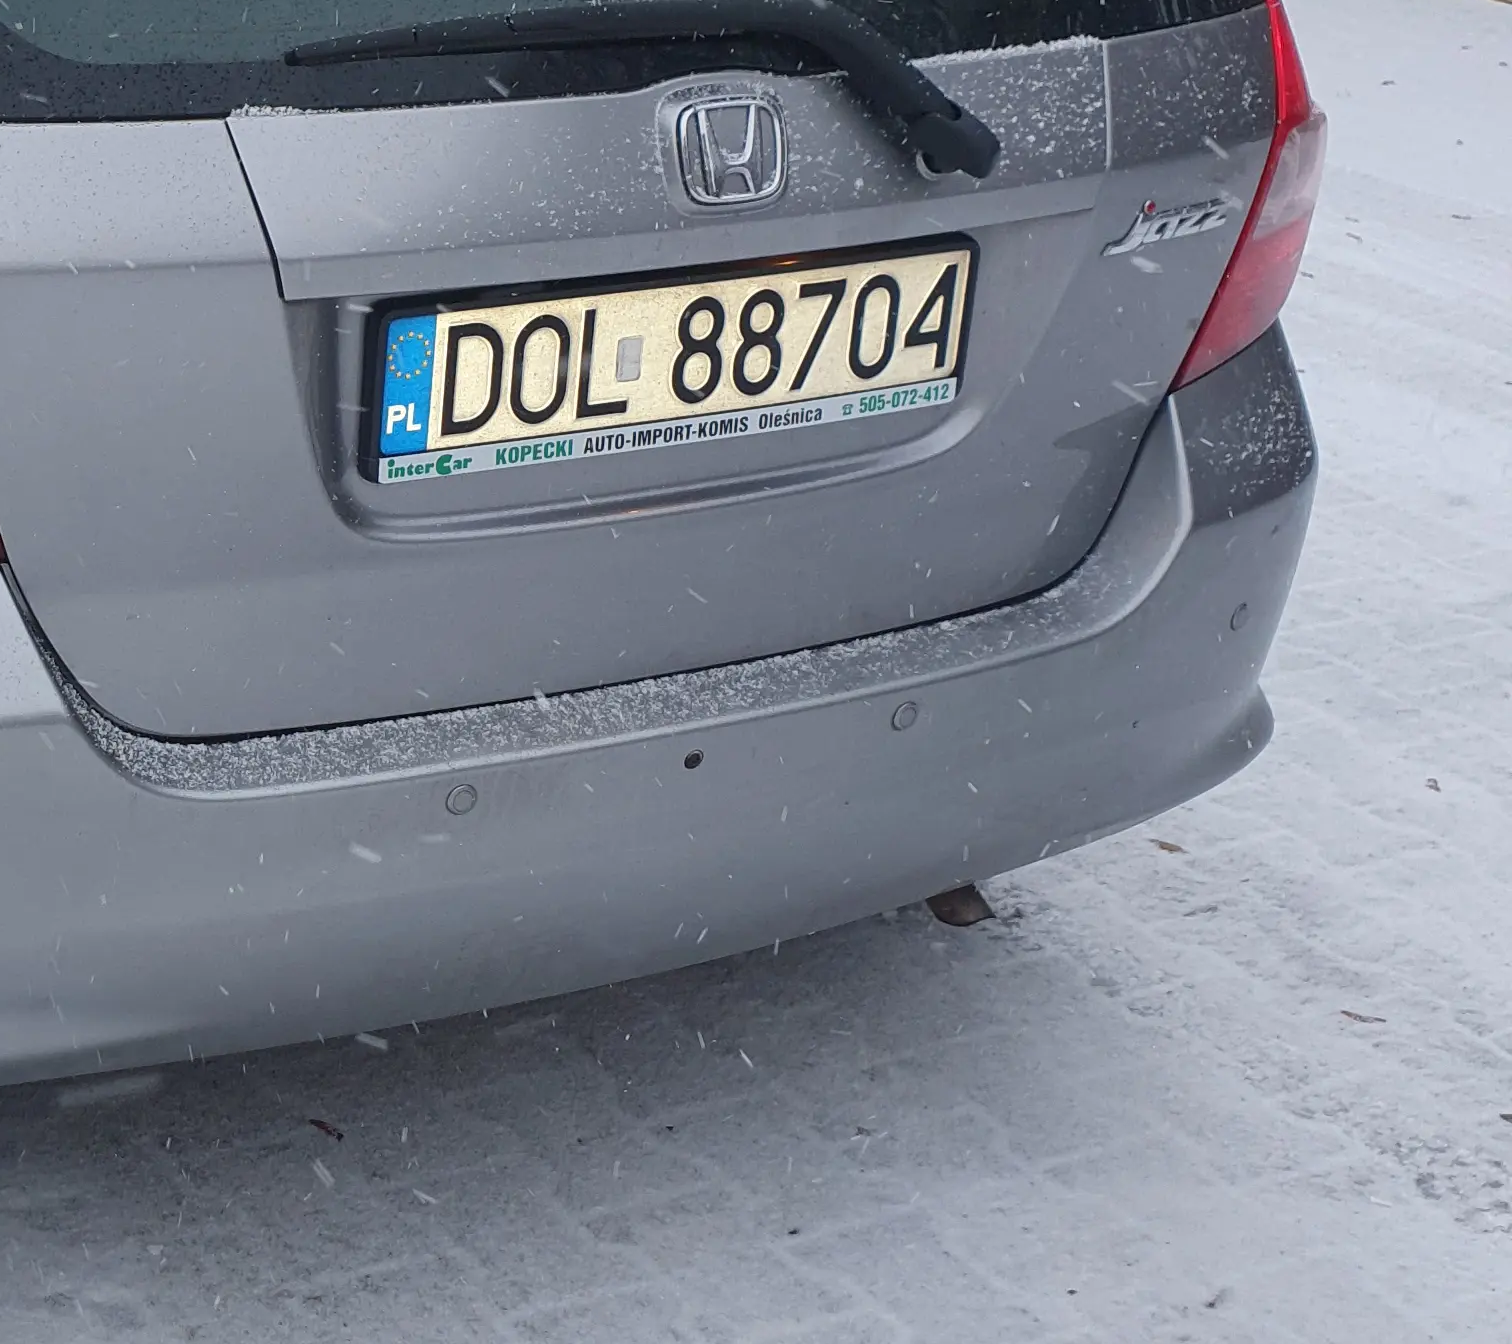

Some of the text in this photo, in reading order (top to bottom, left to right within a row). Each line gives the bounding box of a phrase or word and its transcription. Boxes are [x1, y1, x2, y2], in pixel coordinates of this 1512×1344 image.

[440, 263, 960, 436] DOL 88704
[385, 403, 422, 435] PL
[495, 438, 574, 466] KOPECKI
[583, 416, 750, 455] AUTO-IMPORT-KOMIS
[758, 406, 823, 431] Oleśnica
[858, 383, 950, 415] 505-072-412
